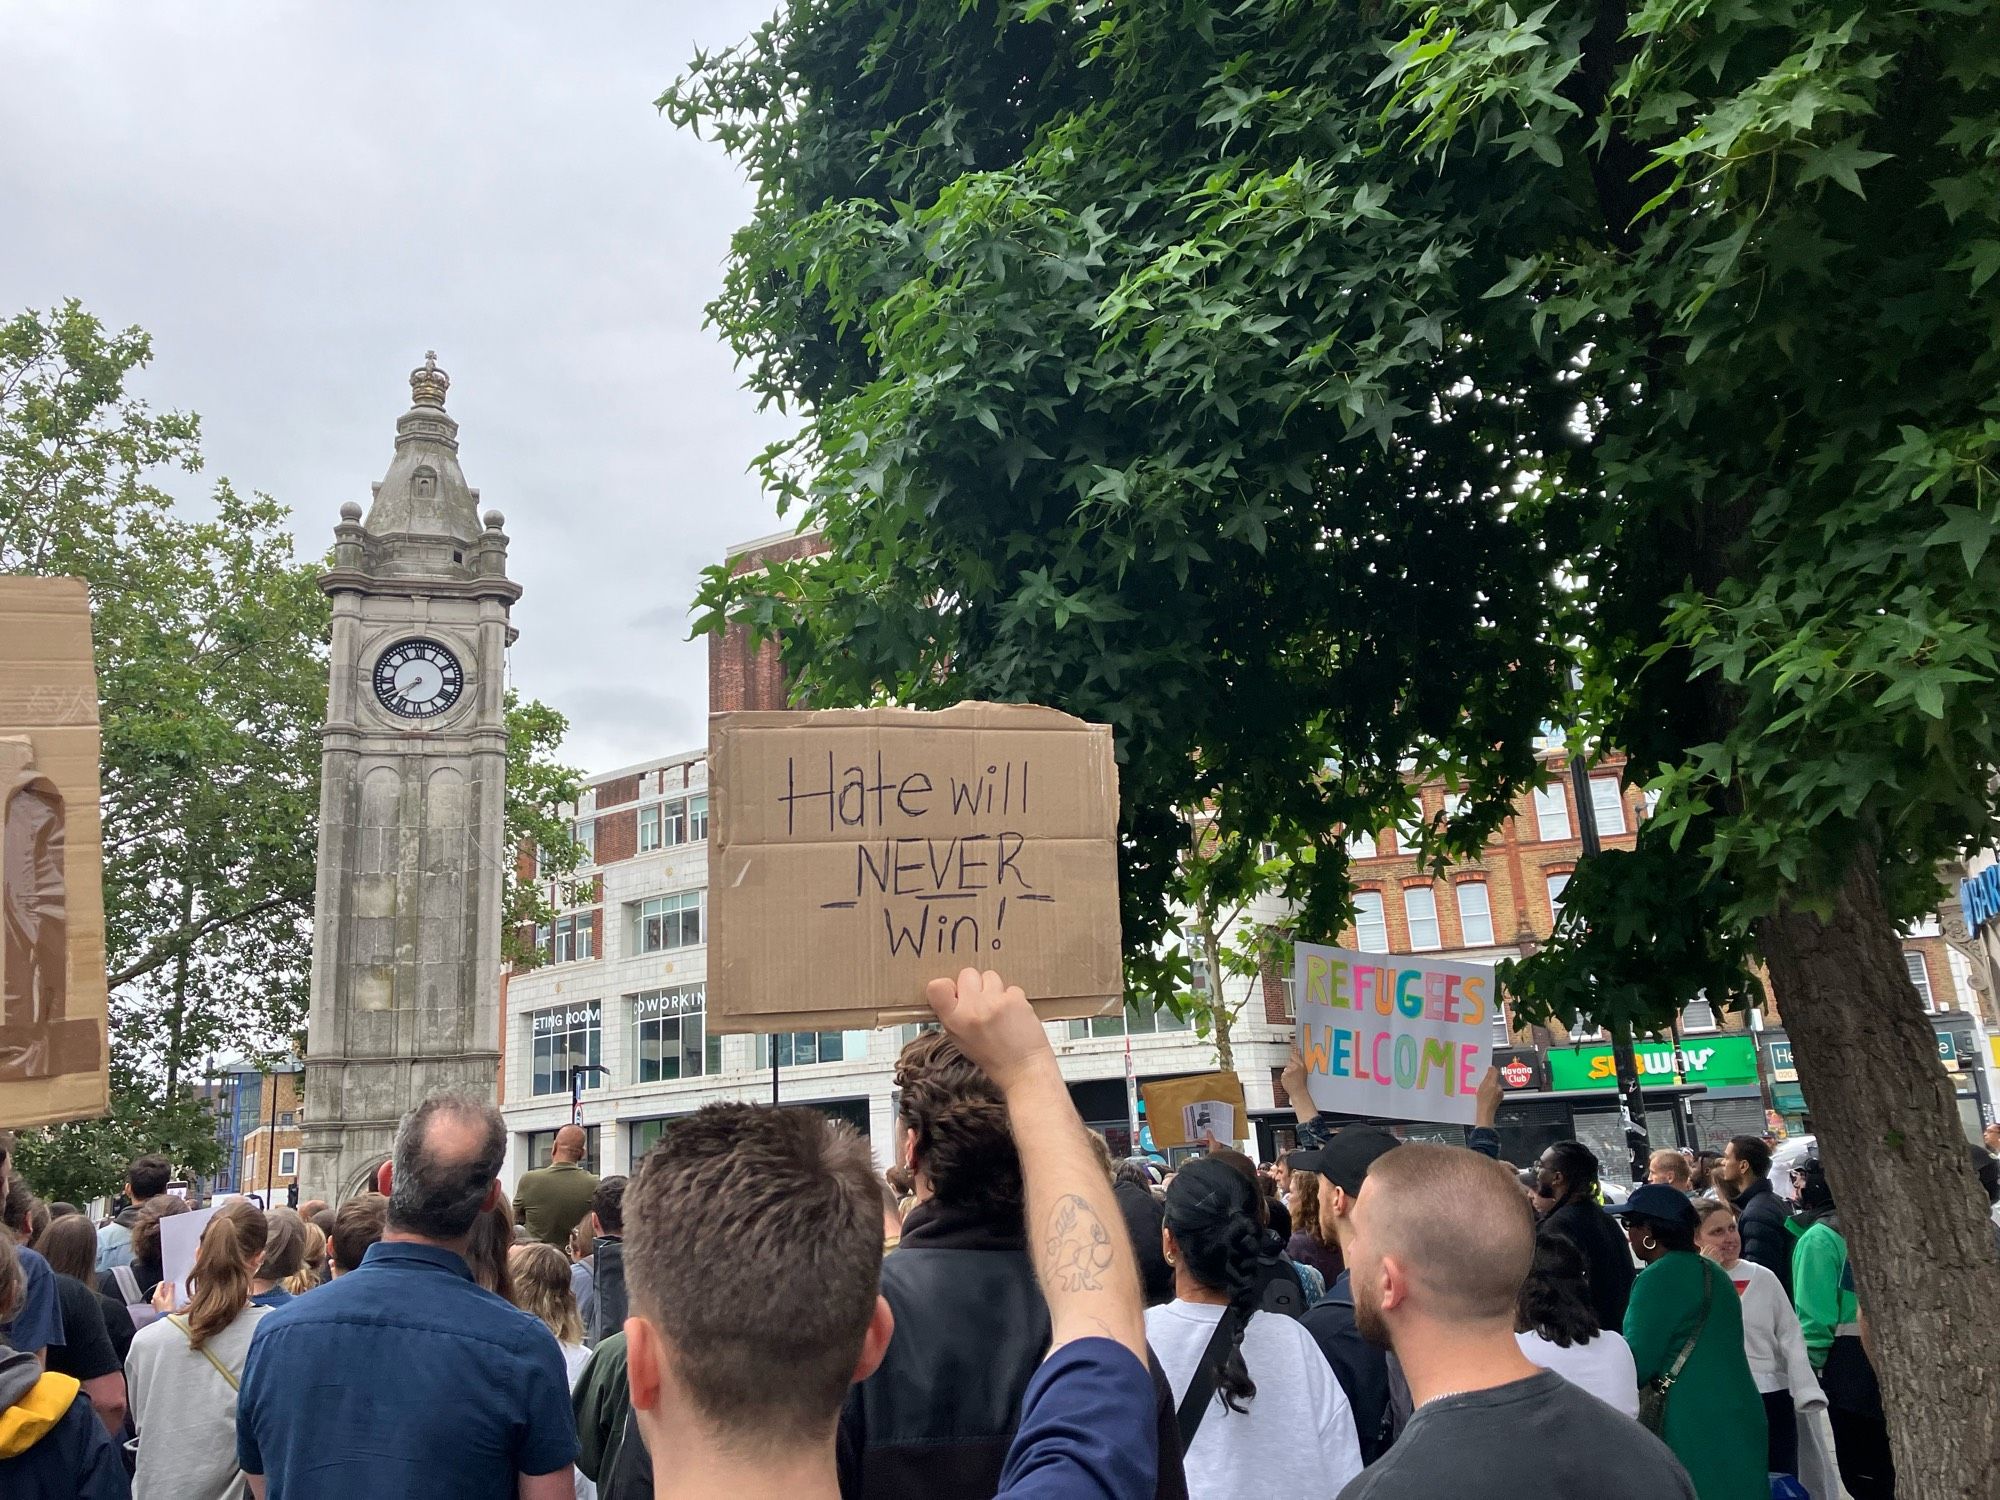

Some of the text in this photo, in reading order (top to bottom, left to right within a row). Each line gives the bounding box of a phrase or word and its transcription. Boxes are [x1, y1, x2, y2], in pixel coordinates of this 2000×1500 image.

[778, 750, 1028, 836] Hate will
[857, 832, 1033, 896] NEVER
[884, 897, 1006, 957] Win!
[1306, 954, 1485, 1025] REFUGEES
[633, 991, 706, 1015] COWORKIN
[534, 1008, 601, 1030] ETING ROOM
[1303, 1023, 1479, 1097] WELCOME
[1776, 1048, 1794, 1063] He
[1938, 1042, 1949, 1054] e
[1501, 1066, 1533, 1076] Havana
[1508, 1074, 1527, 1083] Club
